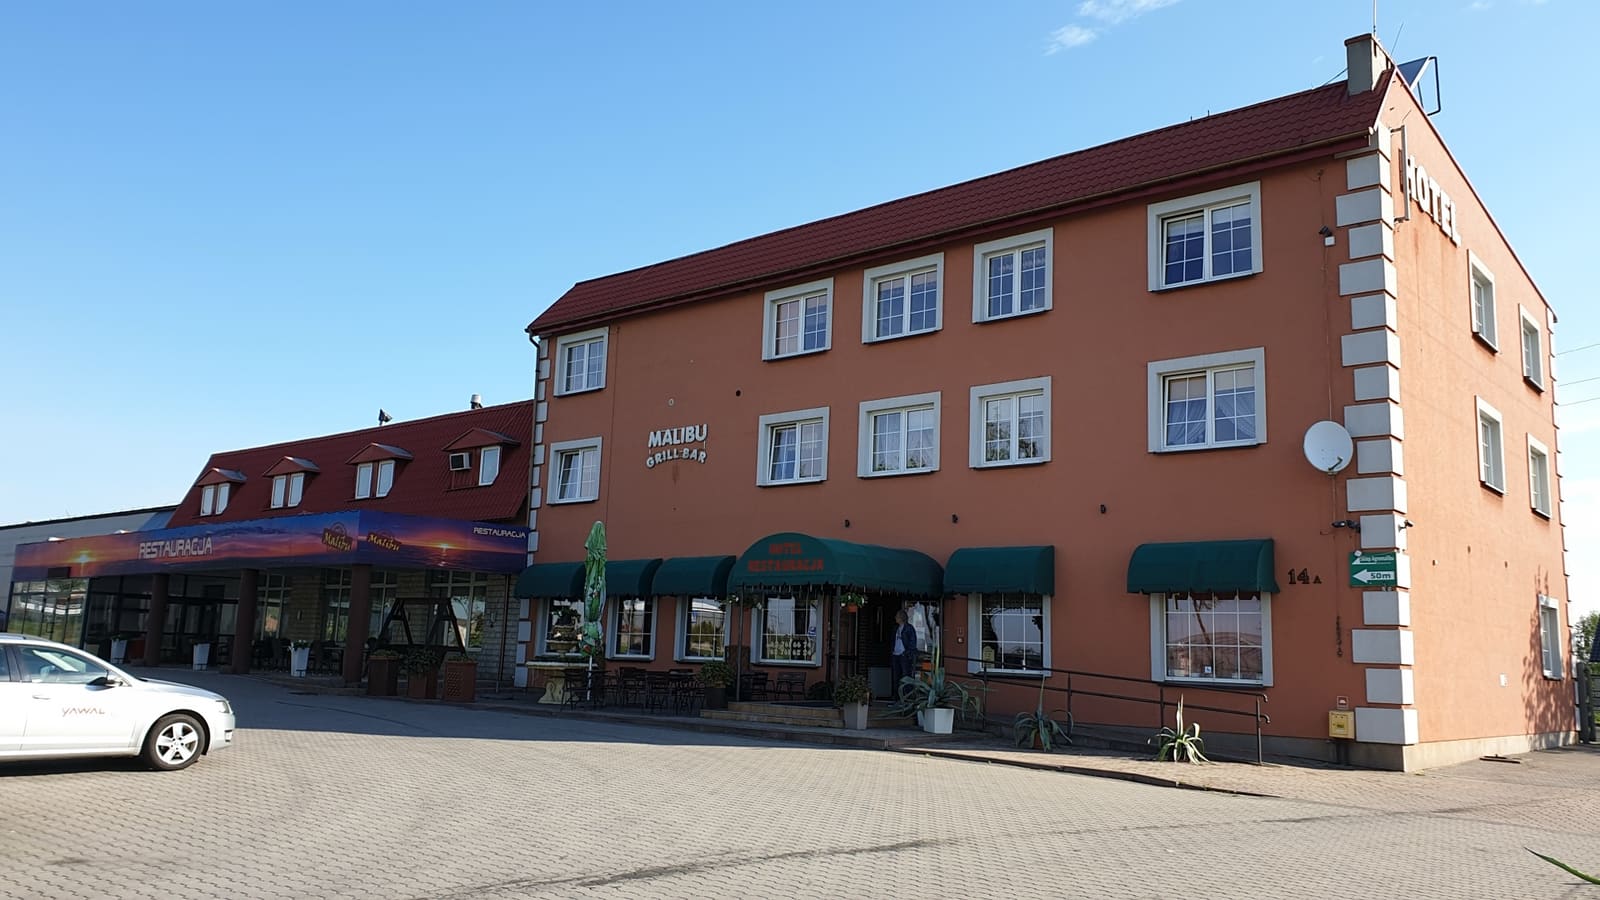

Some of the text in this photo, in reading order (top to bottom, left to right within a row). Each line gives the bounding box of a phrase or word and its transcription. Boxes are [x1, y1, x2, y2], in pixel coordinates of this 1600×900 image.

[1406, 154, 1462, 248] HOTEL
[648, 423, 708, 448] MALIBU
[473, 526, 526, 538] RESTAURACJA
[138, 536, 213, 559] RESTAURACJA
[367, 533, 401, 551] Malibu
[1288, 568, 1310, 584] 14
[62, 706, 106, 718] YAWAL
